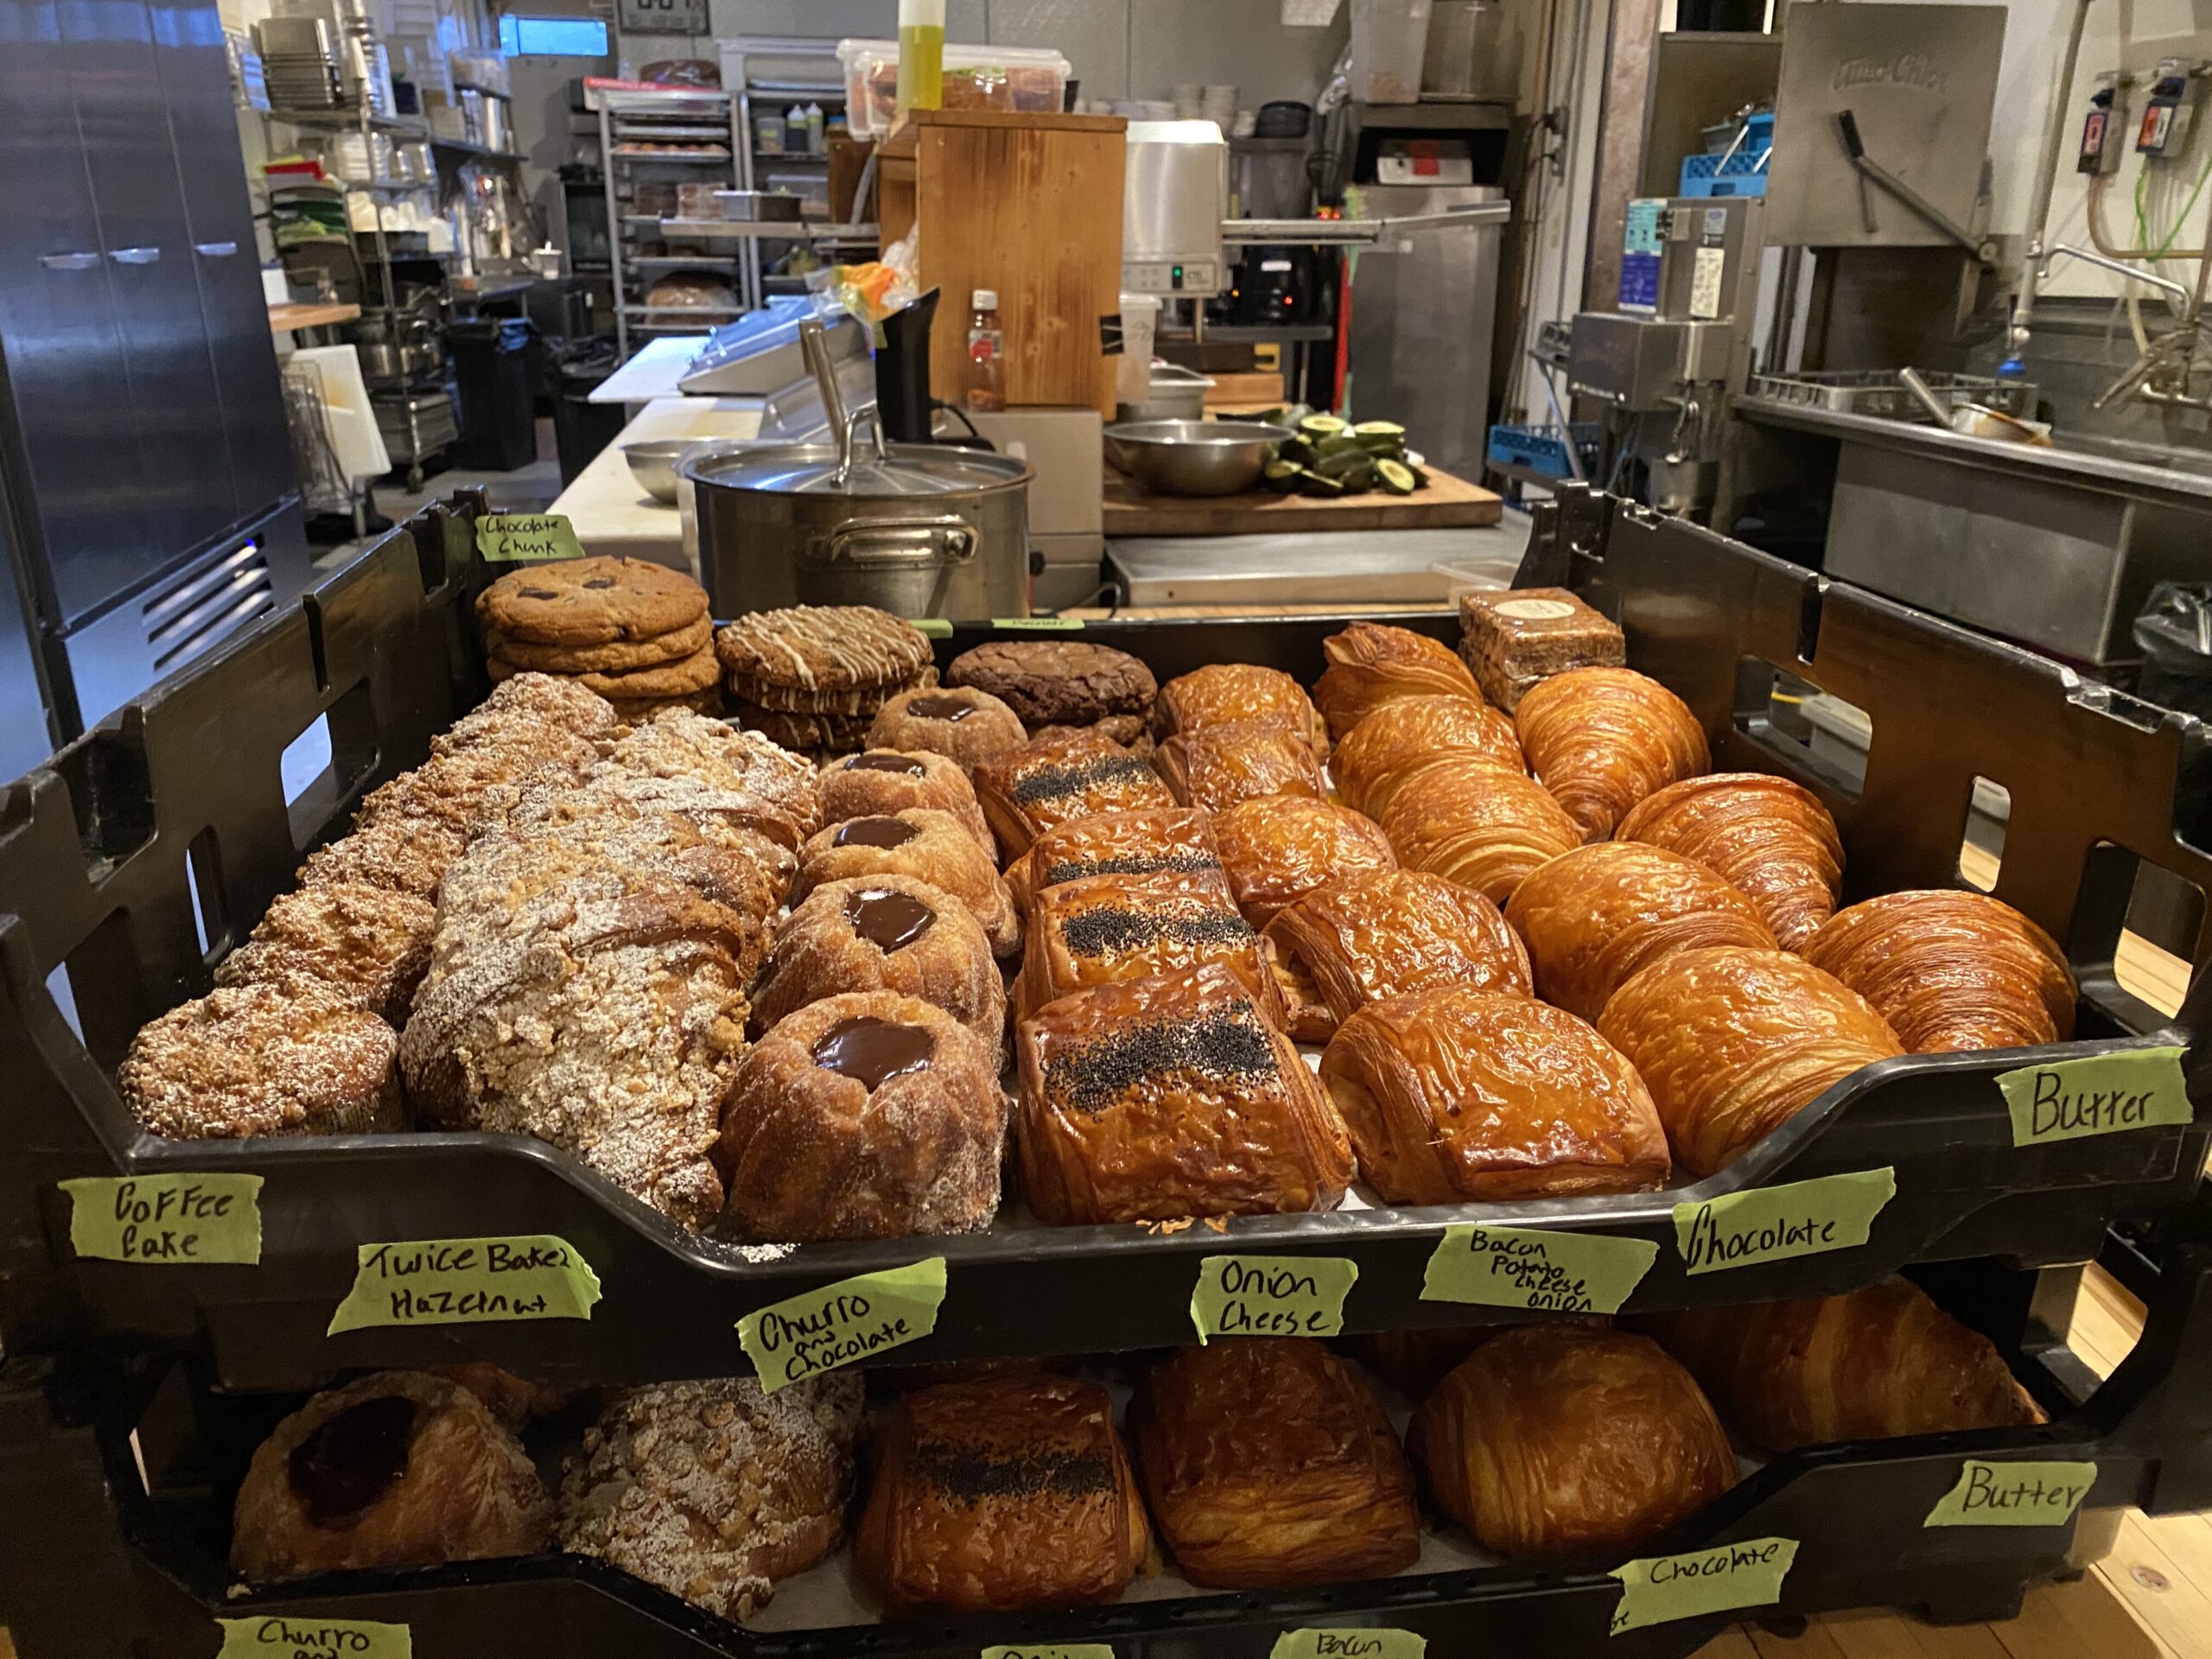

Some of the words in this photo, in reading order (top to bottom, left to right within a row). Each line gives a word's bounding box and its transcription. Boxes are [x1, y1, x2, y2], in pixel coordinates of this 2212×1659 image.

[486, 517, 559, 536] Chocolate
[2032, 1071, 2155, 1136] Butter
[1470, 1229, 1547, 1259] Bacon
[1687, 1204, 1836, 1270] Chocolate
[365, 1244, 479, 1278] Twice
[1220, 1260, 1318, 1299] Onion
[759, 1295, 870, 1351] Churro
[1218, 1300, 1331, 1335] Cheese
[785, 1318, 912, 1381] Chocolate
[1962, 1465, 2085, 1512] Butter
[1649, 1543, 1780, 1584] Chocolate
[257, 1619, 371, 1651] Churro
